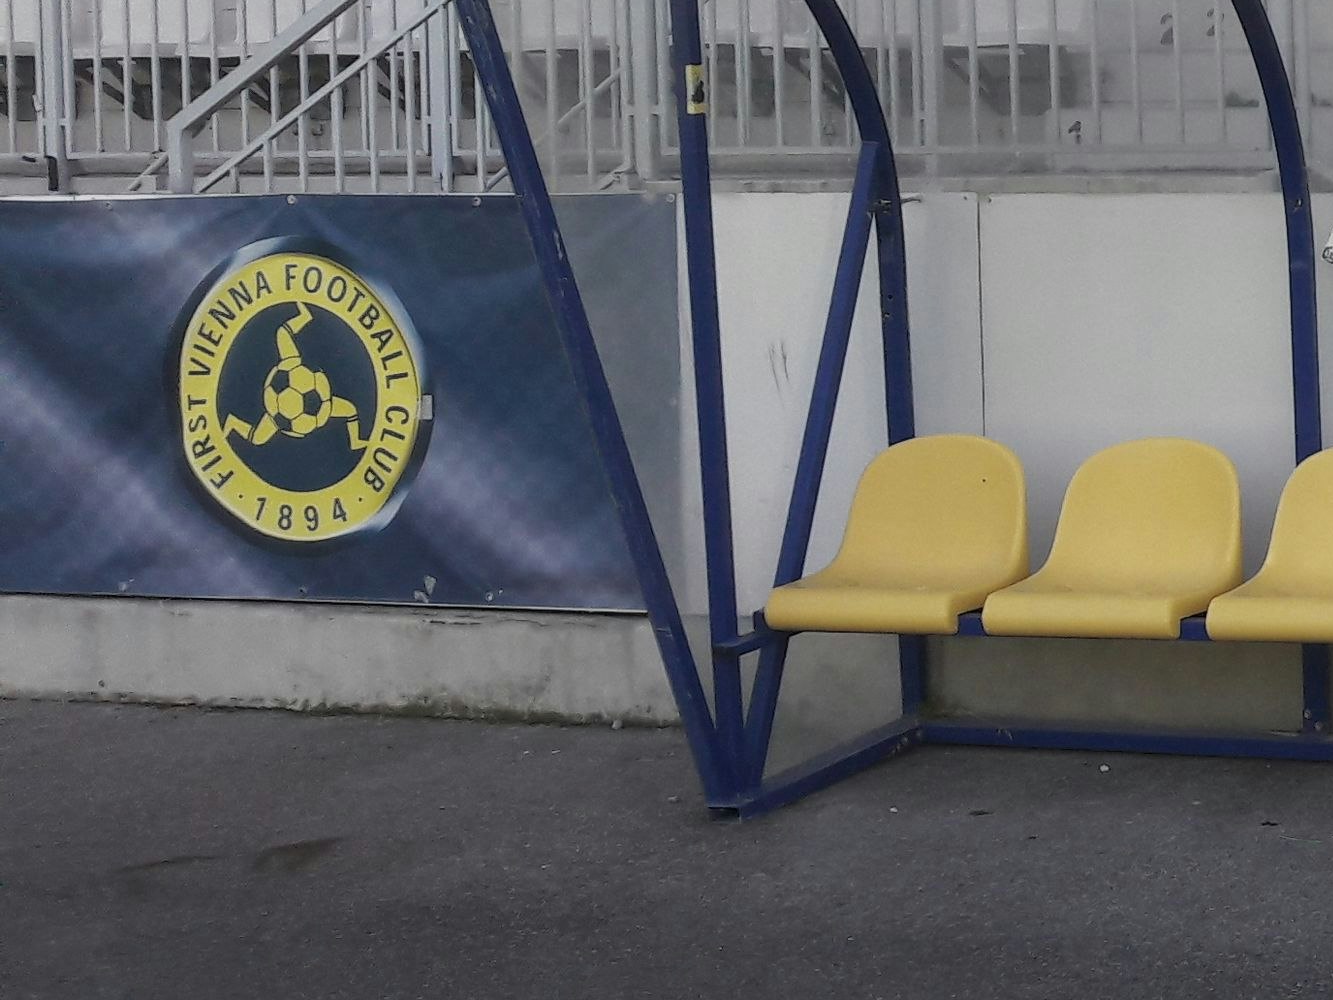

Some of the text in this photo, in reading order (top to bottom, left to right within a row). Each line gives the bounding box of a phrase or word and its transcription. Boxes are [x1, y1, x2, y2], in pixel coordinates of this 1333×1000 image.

[187, 264, 409, 493] FIRST VIENNA FOOTBALL CLUB
[253, 497, 348, 531] 1894
